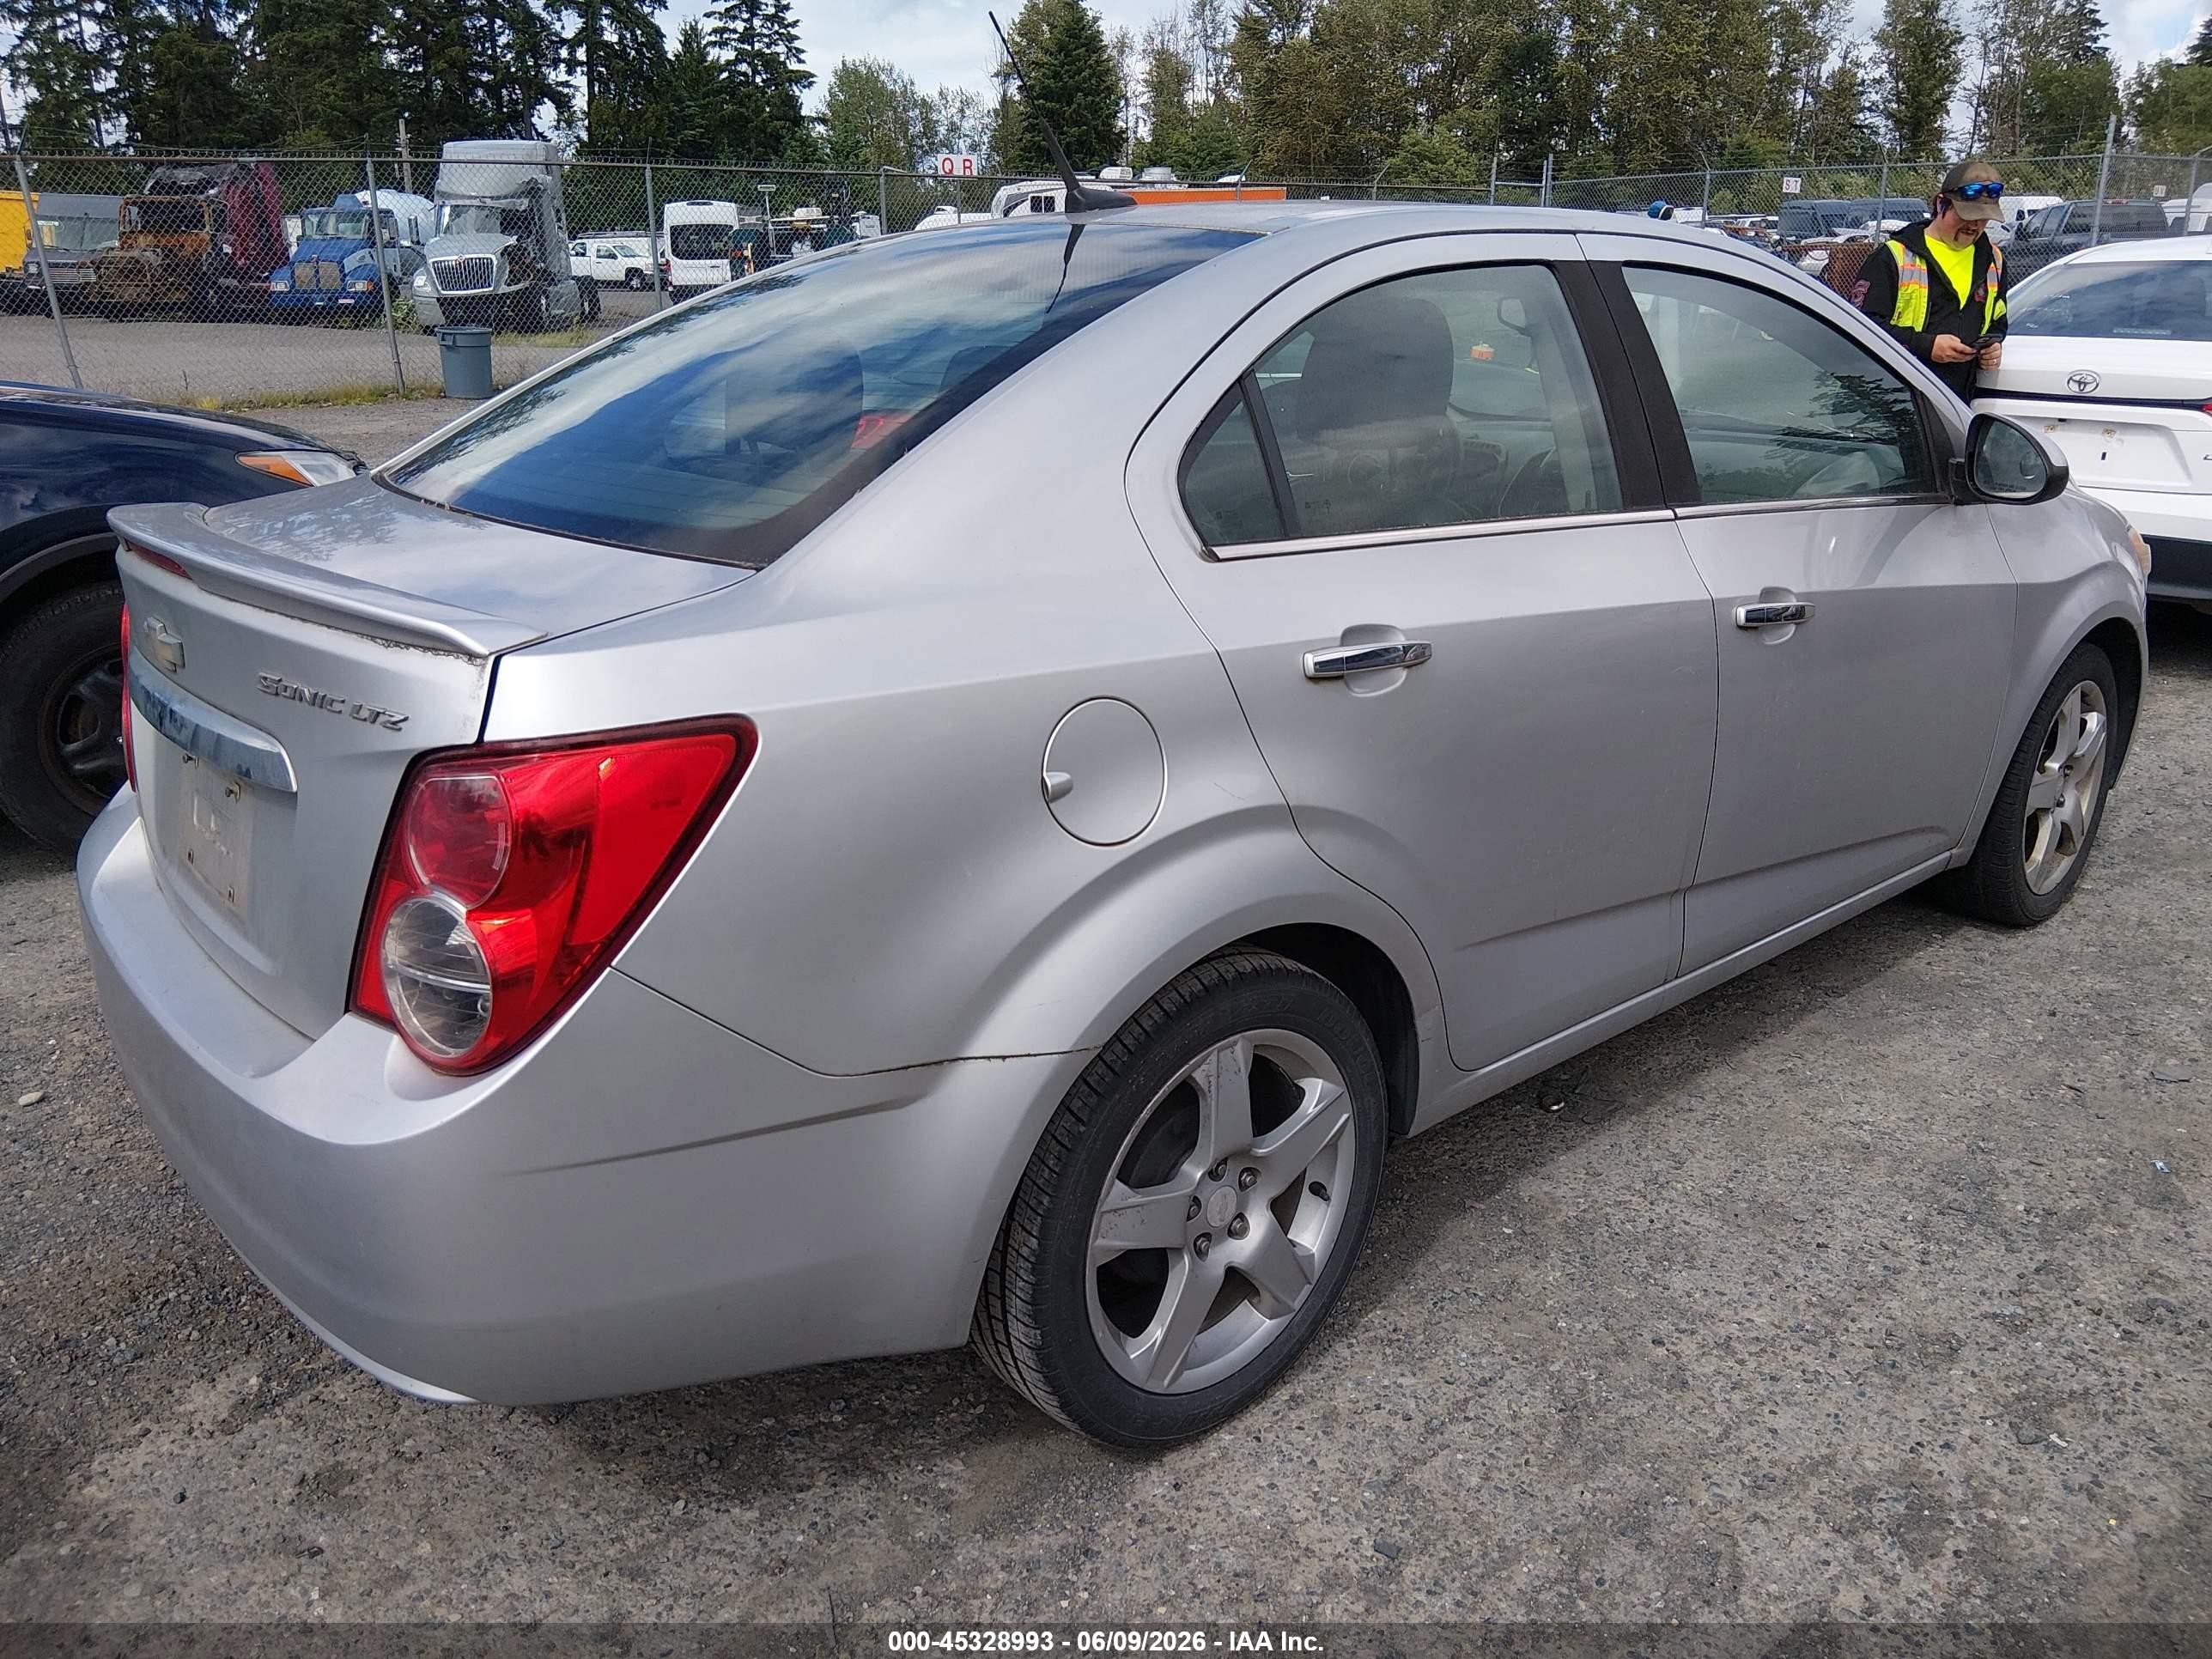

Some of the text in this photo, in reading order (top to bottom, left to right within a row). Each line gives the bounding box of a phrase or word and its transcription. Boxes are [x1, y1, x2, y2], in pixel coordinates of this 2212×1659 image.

[942, 157, 973, 177] Q R
[1785, 179, 1800, 191] S T
[257, 672, 410, 732] SONIC LTZ
